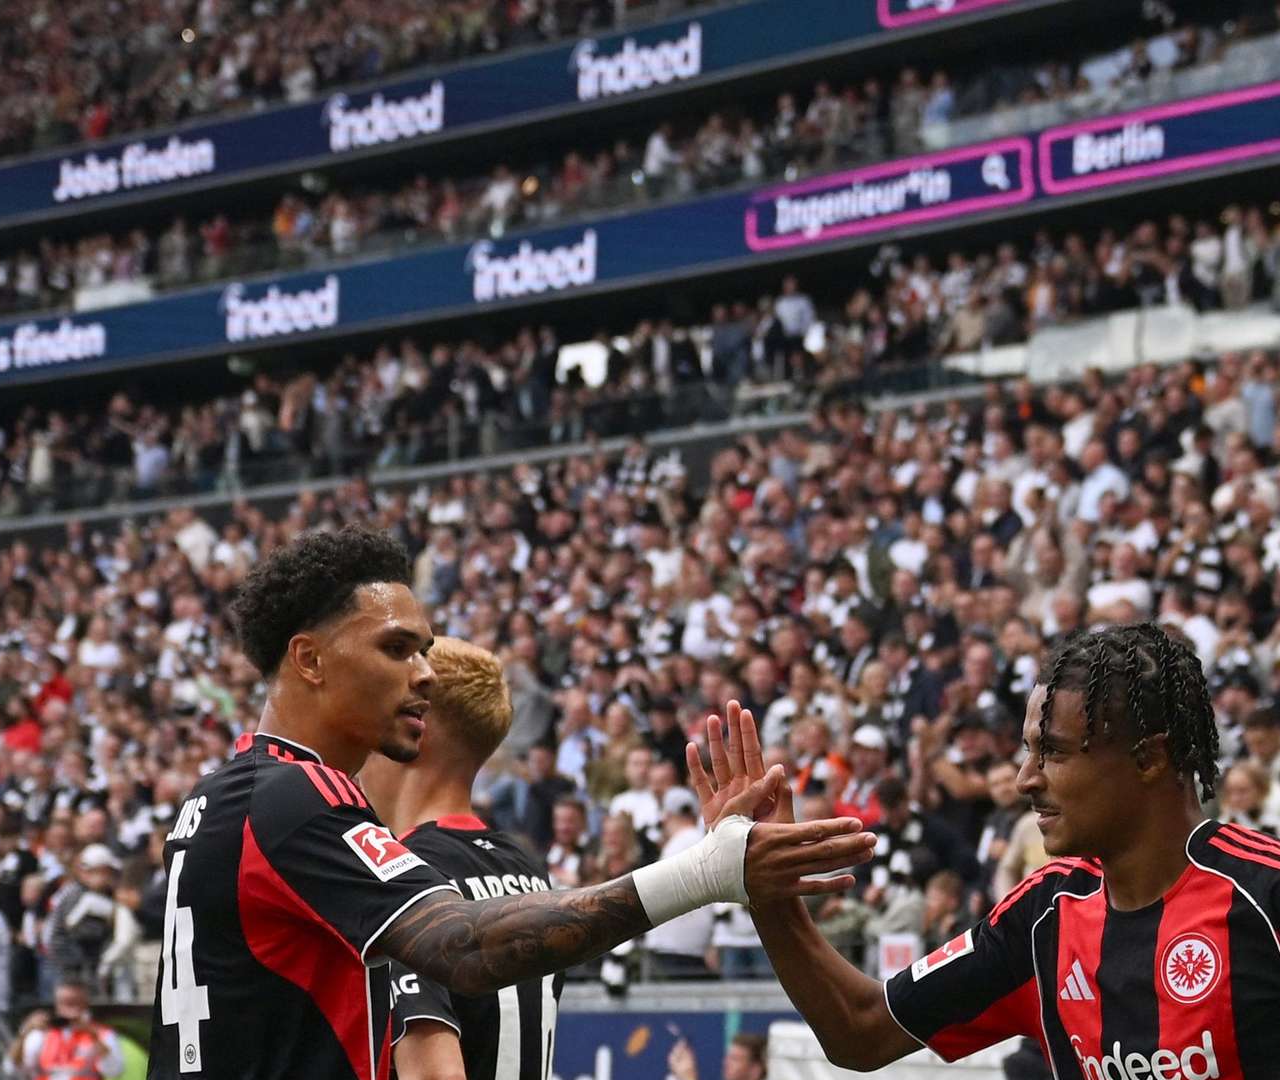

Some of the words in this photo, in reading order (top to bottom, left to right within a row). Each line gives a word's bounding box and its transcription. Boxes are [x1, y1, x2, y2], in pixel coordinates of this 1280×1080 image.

[570, 22, 701, 101] indeed
[327, 80, 444, 151] indeed
[1073, 122, 1164, 175] Berlin
[54, 154, 120, 201] Jobs
[467, 227, 597, 302] indeed
[225, 275, 339, 342] indeed
